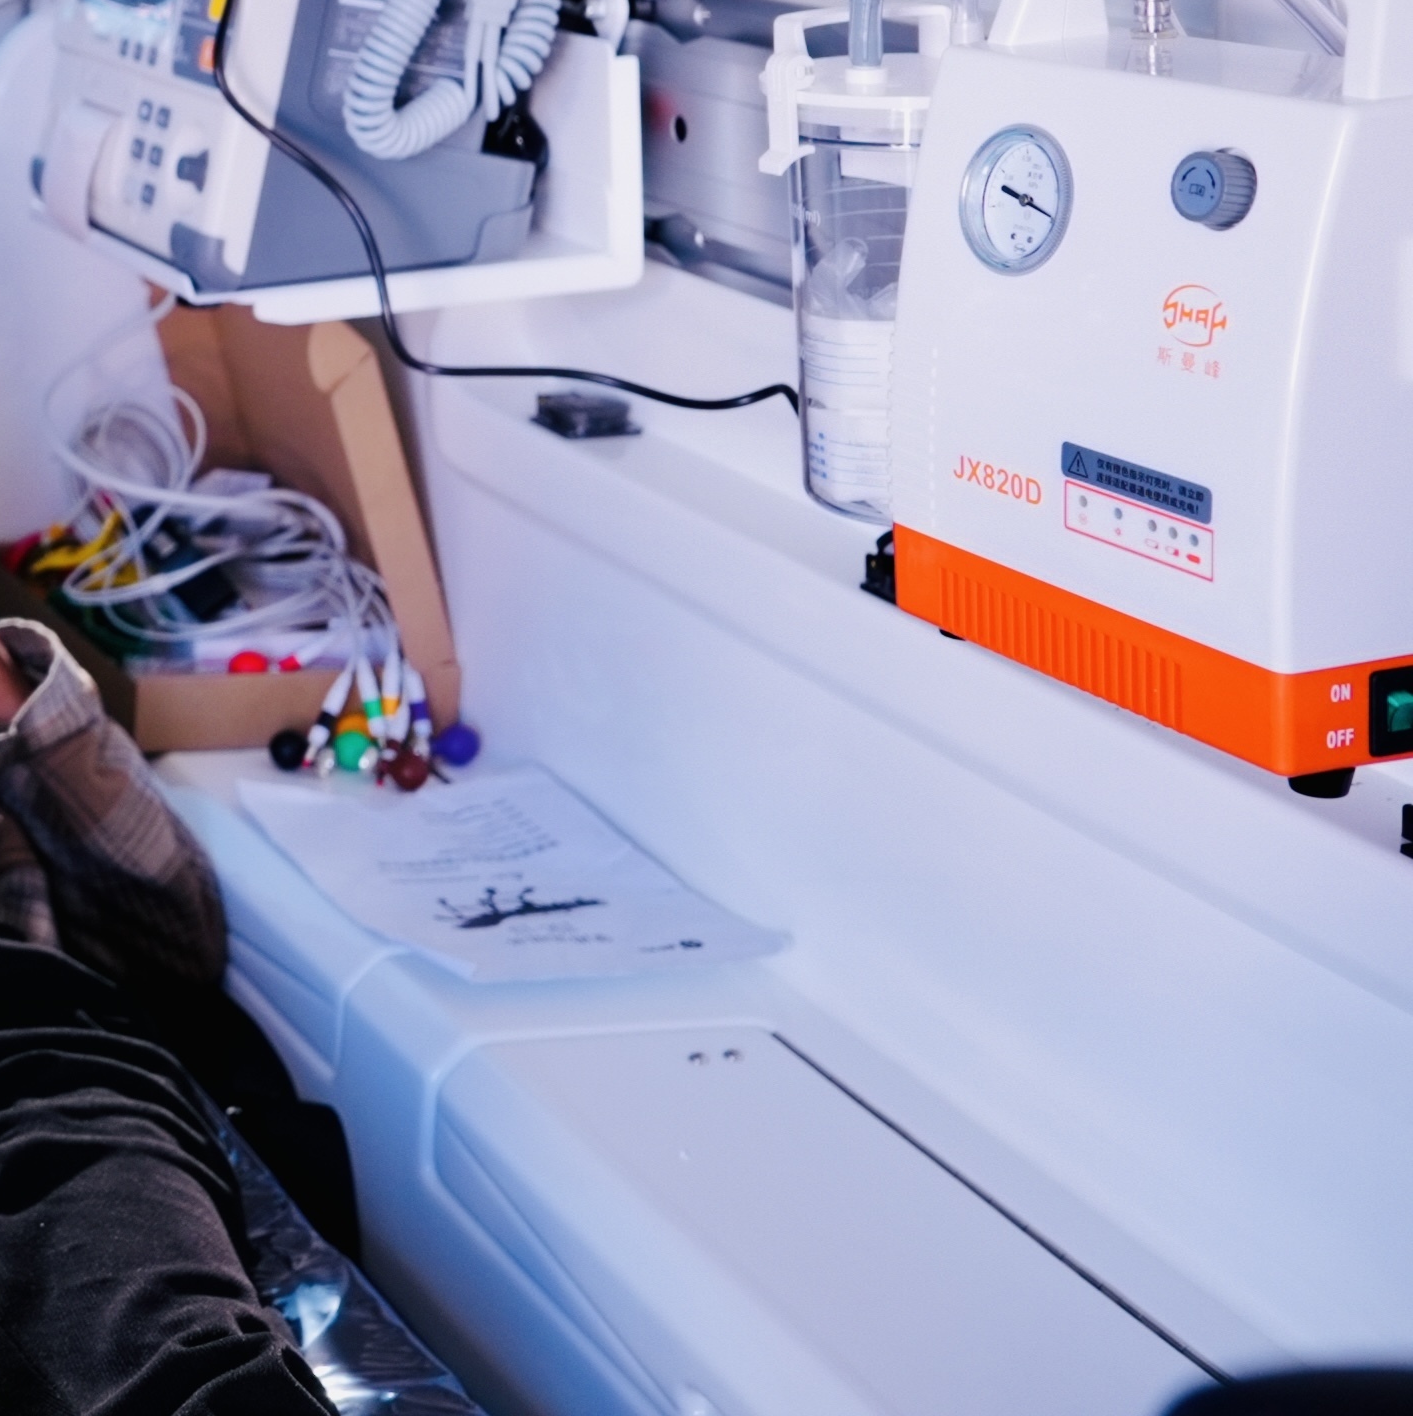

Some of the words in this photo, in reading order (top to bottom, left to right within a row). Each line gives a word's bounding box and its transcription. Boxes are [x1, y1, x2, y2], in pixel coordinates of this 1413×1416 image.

[1157, 345, 1221, 379] 斯曼峰
[953, 455, 1042, 505] JX820D
[1330, 683, 1352, 703] ON
[1326, 728, 1355, 749] OFF
